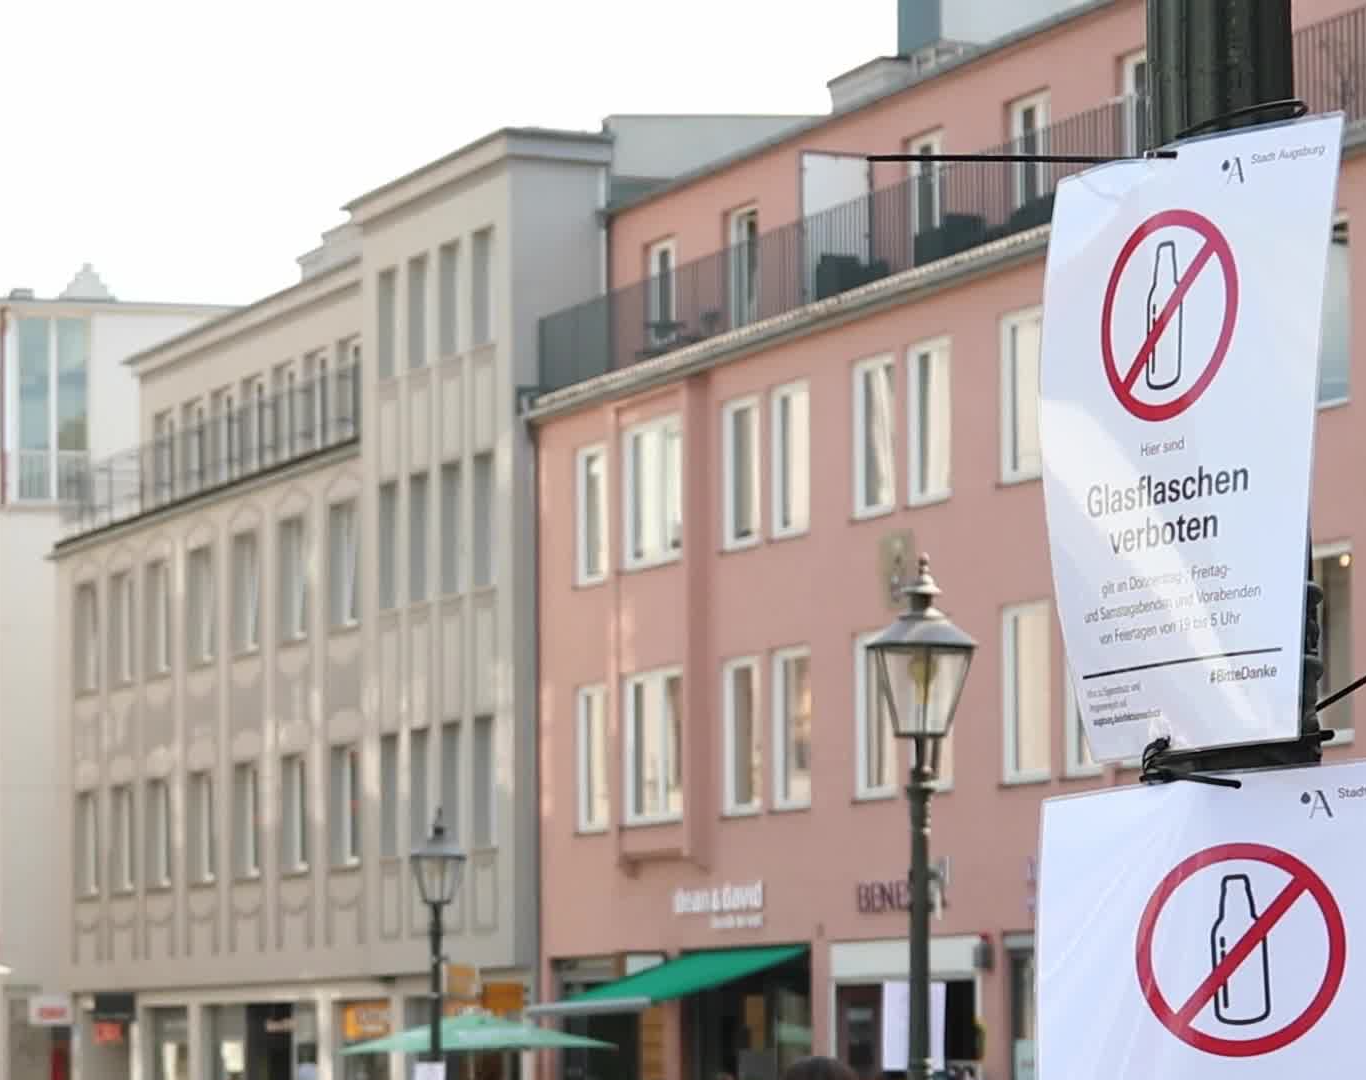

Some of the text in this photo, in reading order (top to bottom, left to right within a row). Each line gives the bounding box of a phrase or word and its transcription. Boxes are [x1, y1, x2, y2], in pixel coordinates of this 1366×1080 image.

[1251, 145, 1325, 164] Stadt Augsburg
[1140, 436, 1185, 457] Hier sind
[1086, 465, 1249, 518] Glasflaschen
[1110, 513, 1219, 554] verboten
[1196, 584, 1262, 605] Vorabenden
[1159, 621, 1176, 634] von
[1220, 610, 1242, 626] Uhr
[1210, 664, 1277, 684] #BitteDanke
